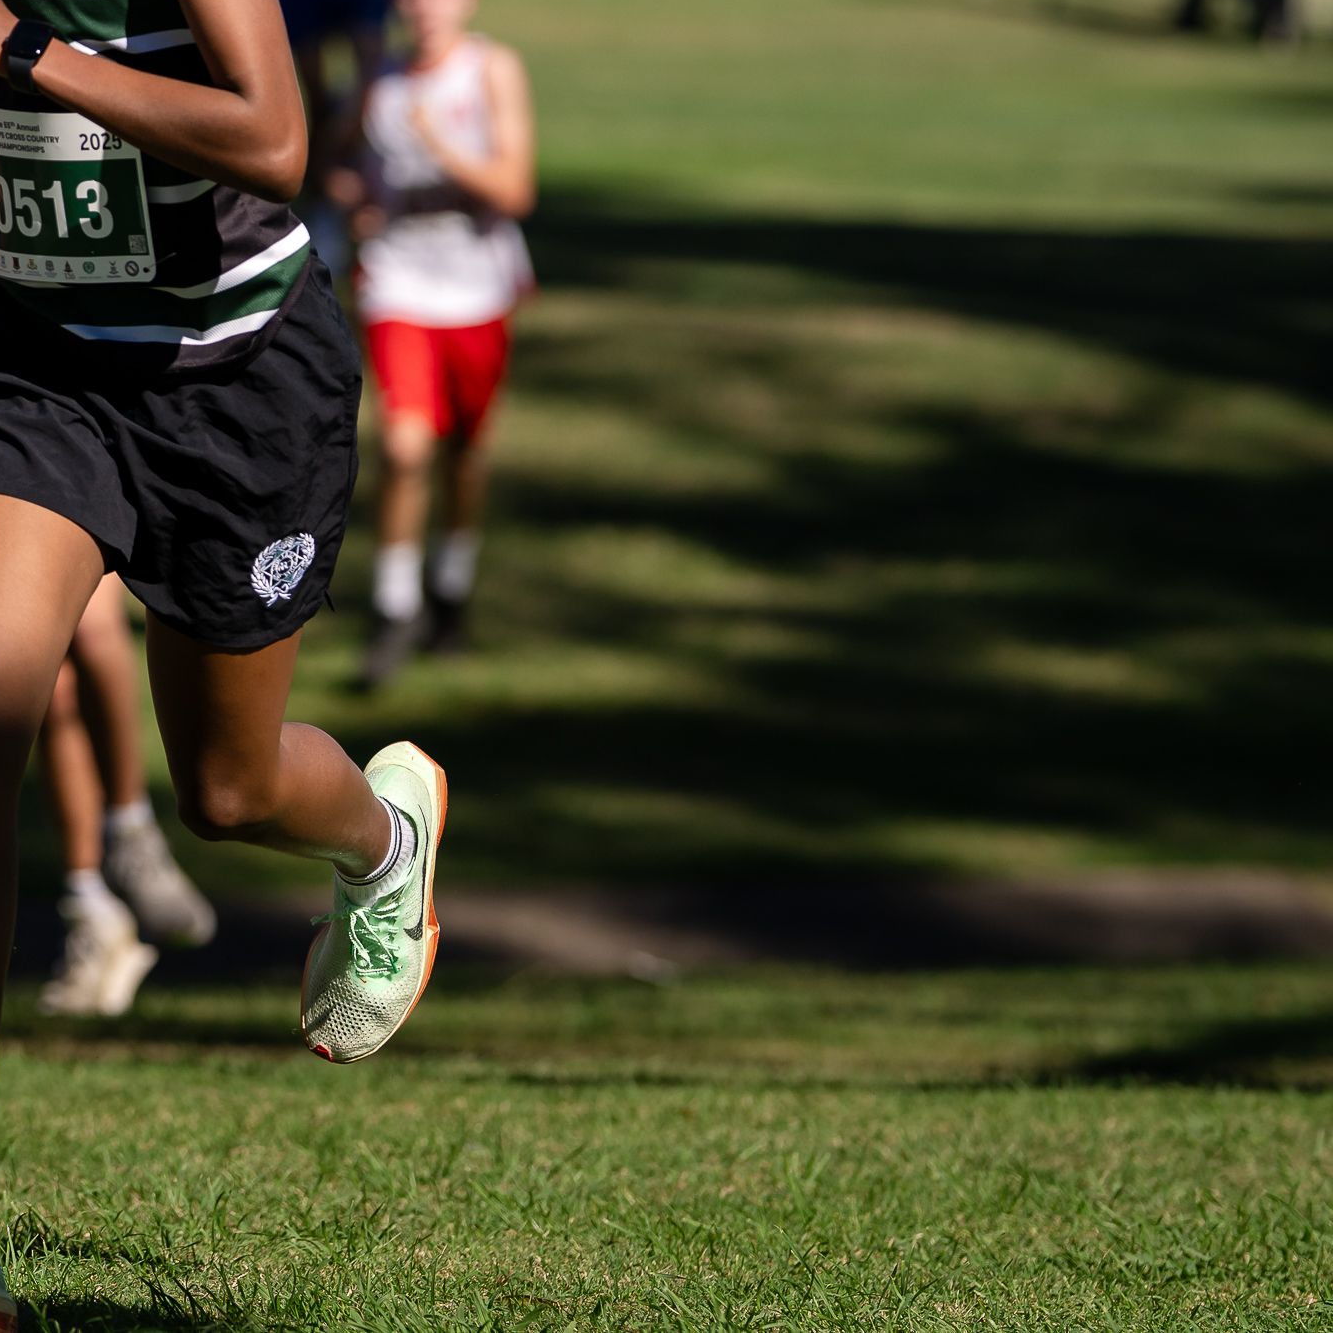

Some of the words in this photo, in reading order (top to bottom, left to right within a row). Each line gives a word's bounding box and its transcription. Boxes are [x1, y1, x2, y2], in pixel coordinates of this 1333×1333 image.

[16, 123, 41, 132] Annual
[5, 132, 26, 141] CROSS
[26, 134, 60, 144] COUNTRY
[78, 132, 123, 151] 2025
